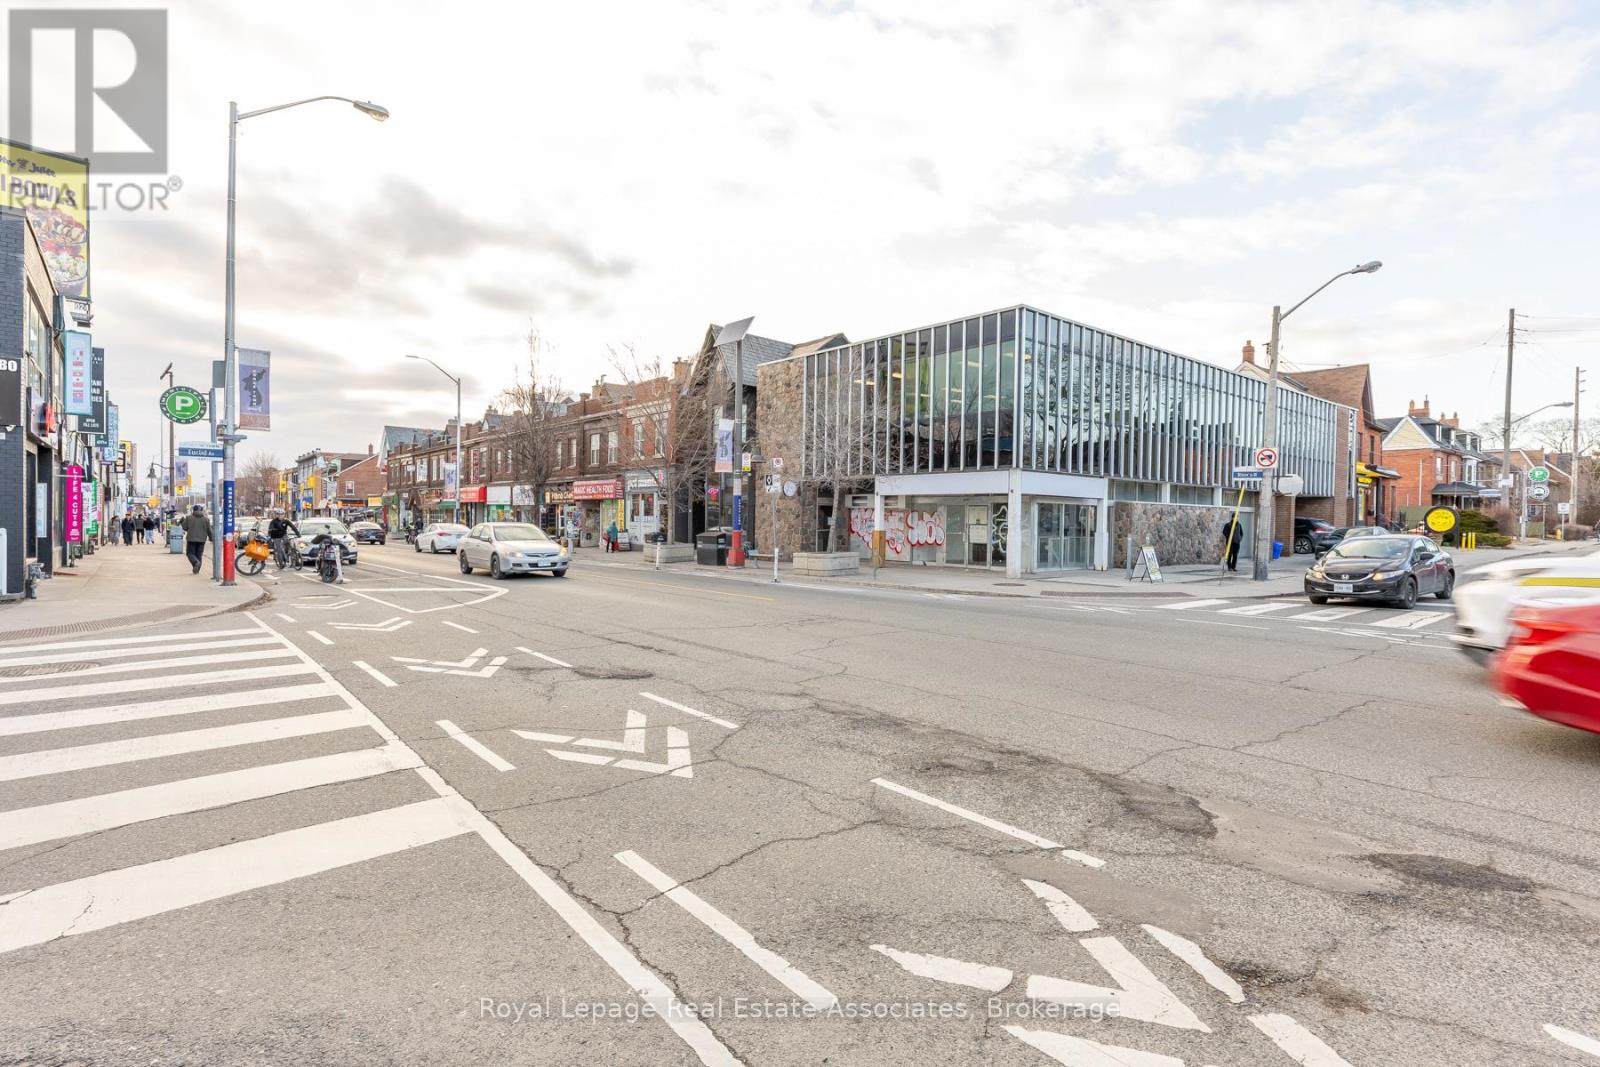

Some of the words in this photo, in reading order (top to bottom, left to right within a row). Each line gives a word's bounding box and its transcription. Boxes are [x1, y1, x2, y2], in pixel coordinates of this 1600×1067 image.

[175, 395, 193, 411] P
[586, 484, 602, 494] HEALTH
[602, 483, 614, 493] FOOD
